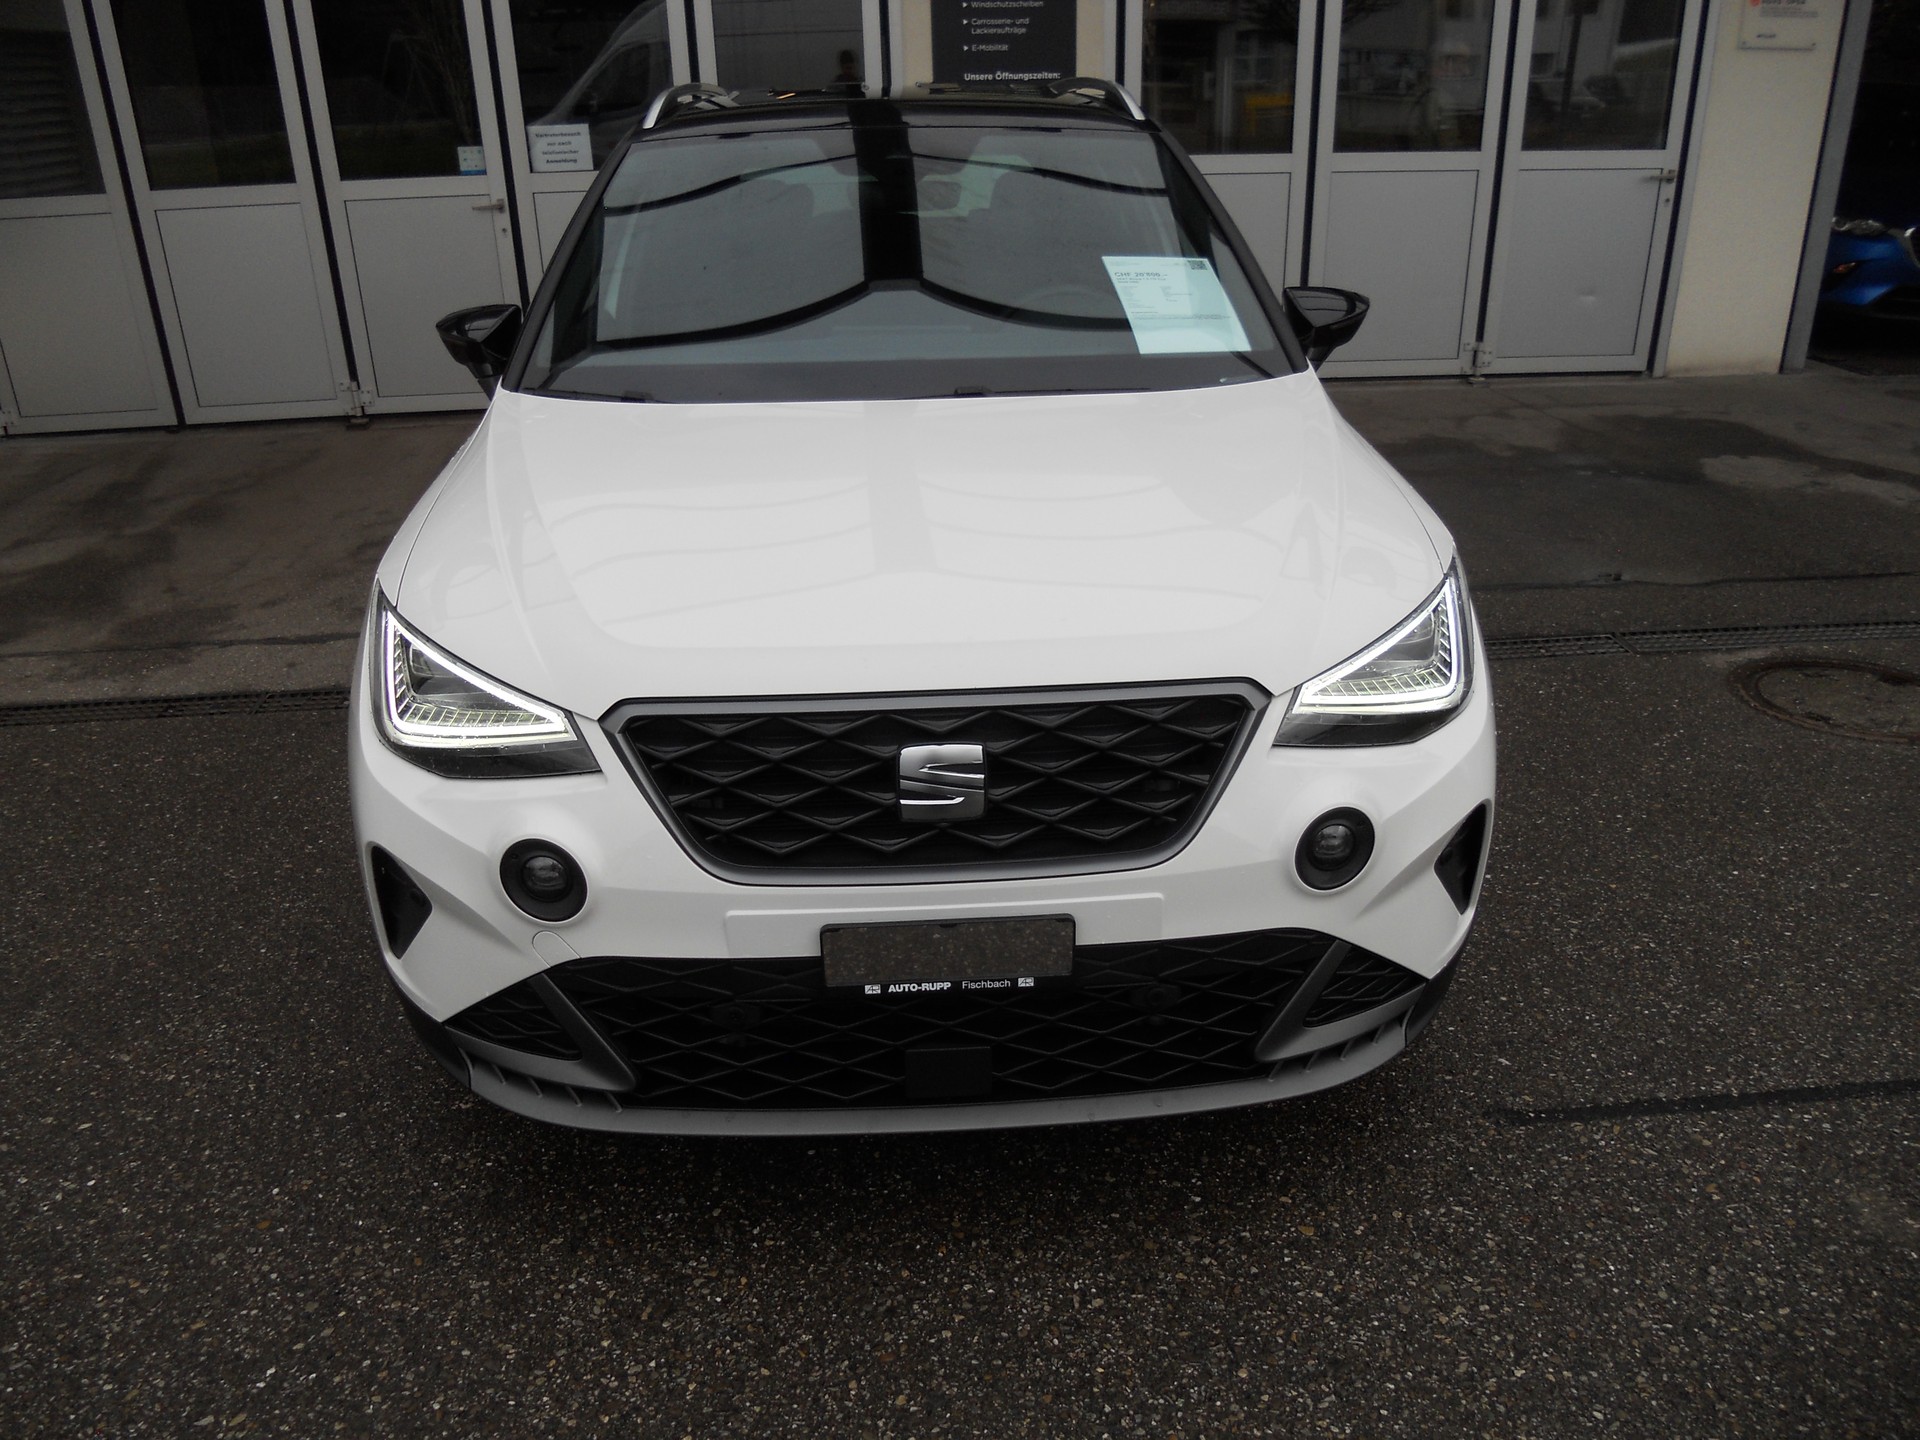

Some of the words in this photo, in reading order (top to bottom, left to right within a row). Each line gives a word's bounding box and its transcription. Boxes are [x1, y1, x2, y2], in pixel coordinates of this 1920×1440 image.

[971, 0, 1044, 8] Windschutzscheiben
[1015, 17, 1030, 25] und
[971, 27, 1027, 35] Lackieraufträge
[972, 44, 1009, 52] E-Mobilität
[964, 72, 993, 81] Unsere
[995, 70, 1061, 82] Öffnungszeiten:
[888, 981, 951, 993] AUTO-RUPP
[962, 979, 1011, 990] Fischbach
